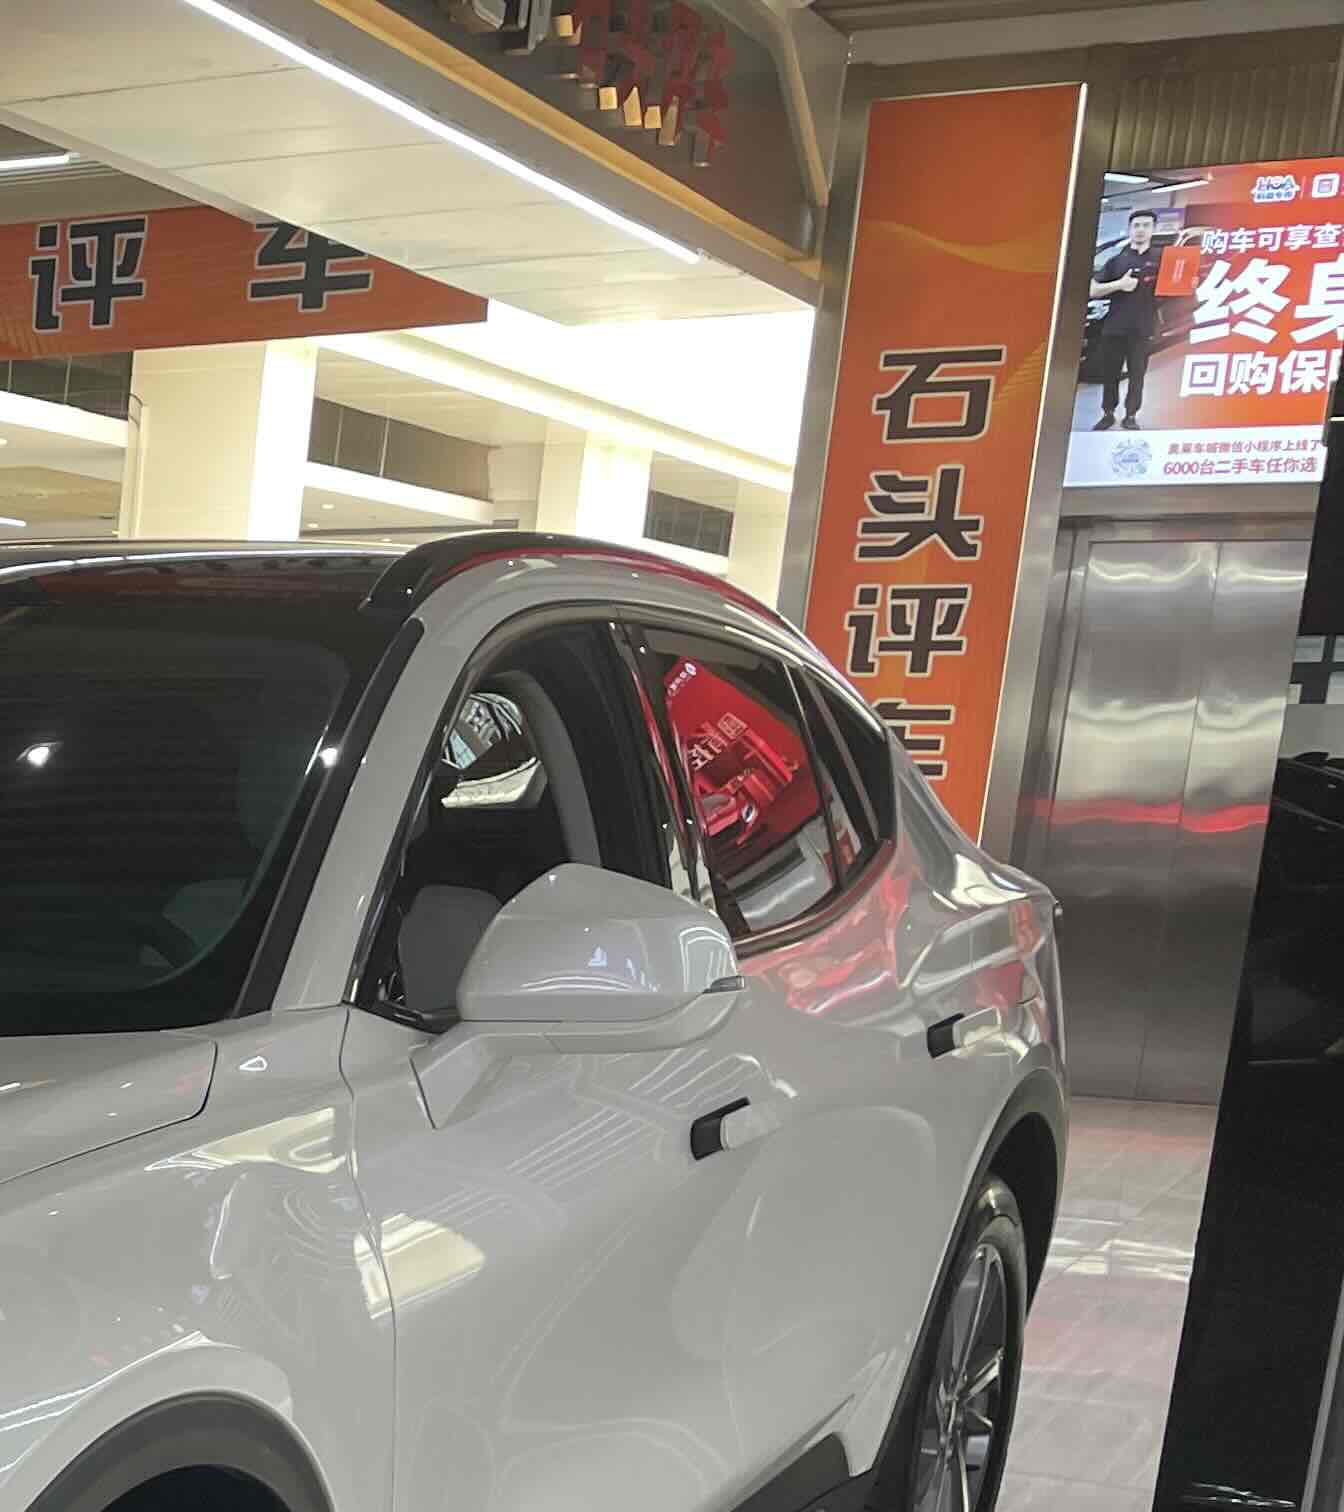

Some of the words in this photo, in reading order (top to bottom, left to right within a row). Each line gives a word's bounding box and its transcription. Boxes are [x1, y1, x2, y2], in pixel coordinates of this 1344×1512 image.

[1163, 457, 1318, 476] 6000台二手车任你选
